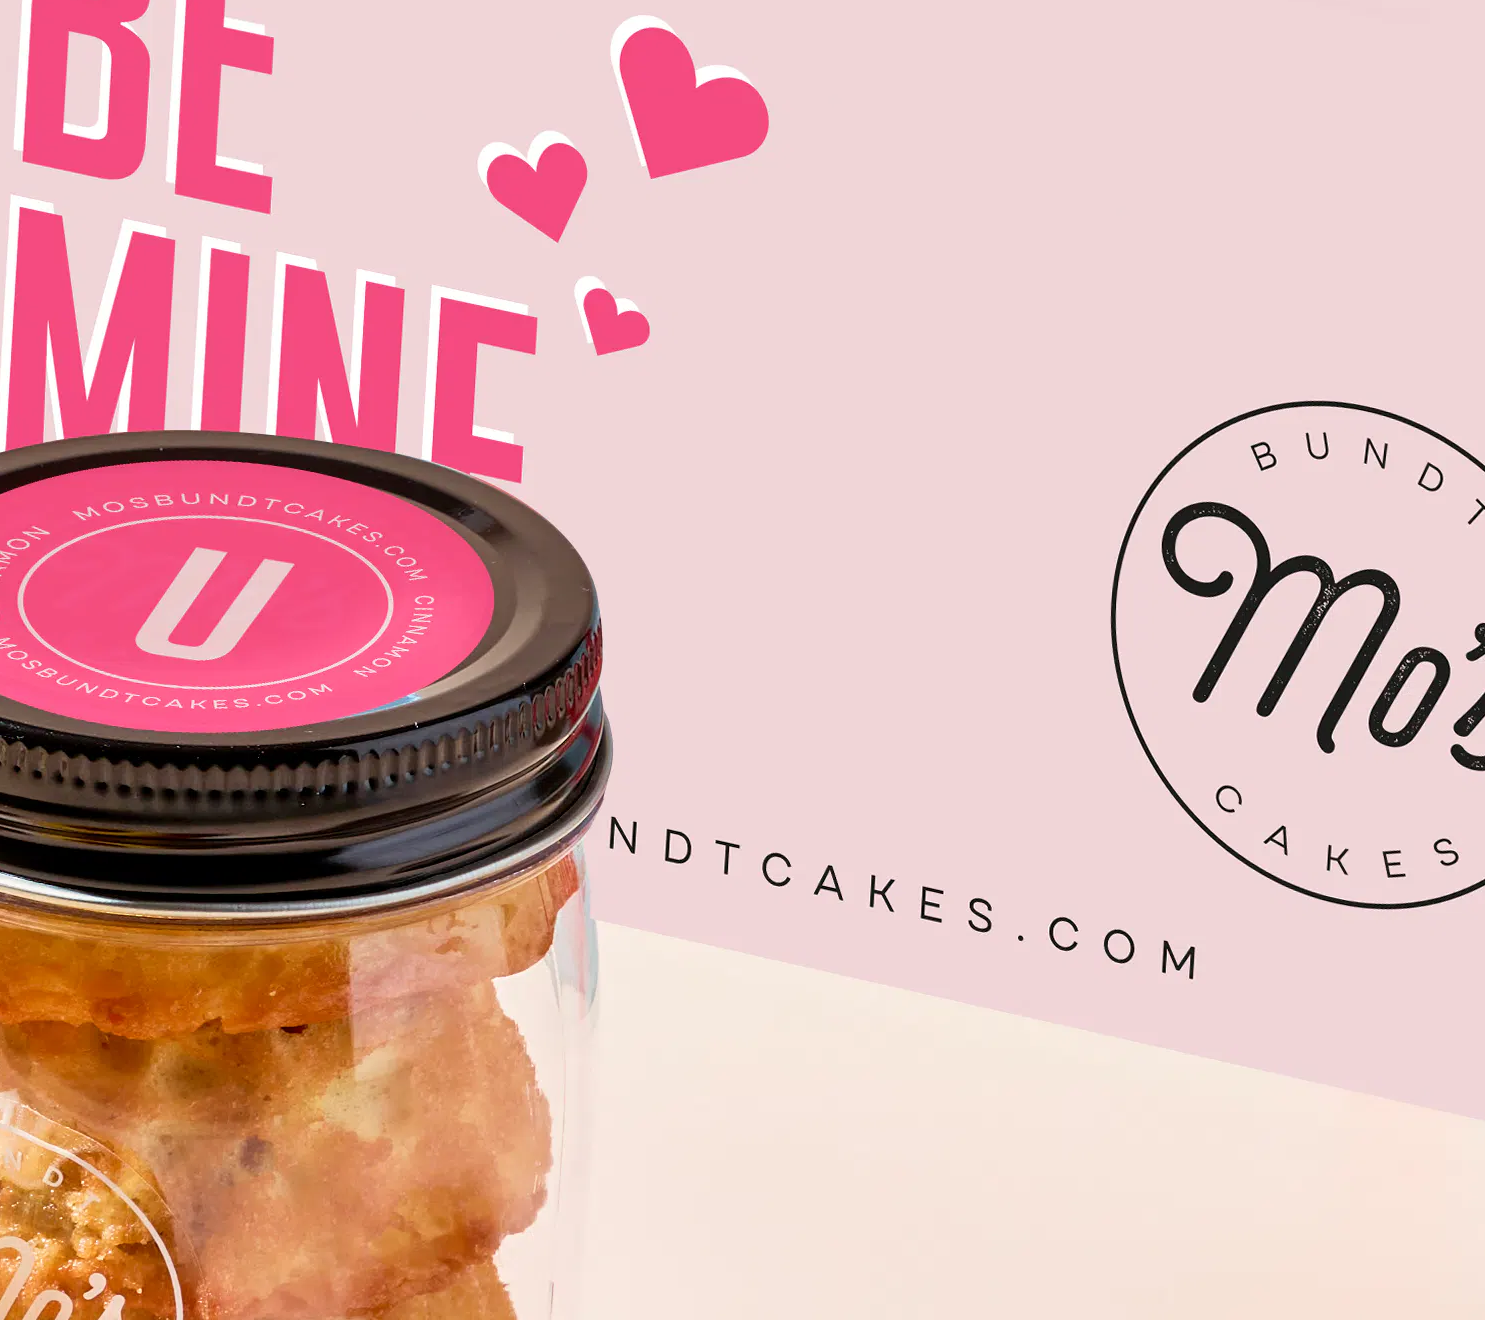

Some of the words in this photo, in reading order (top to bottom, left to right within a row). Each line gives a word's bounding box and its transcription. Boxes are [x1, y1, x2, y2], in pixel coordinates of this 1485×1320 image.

[71, 492, 428, 583] MOSBUNDTCAKES.COM
[134, 546, 296, 662] U
[352, 594, 435, 680] CINNAMON
[1215, 784, 1460, 879] CAKES
[608, 815, 1197, 981] NDTCAKES.COM
